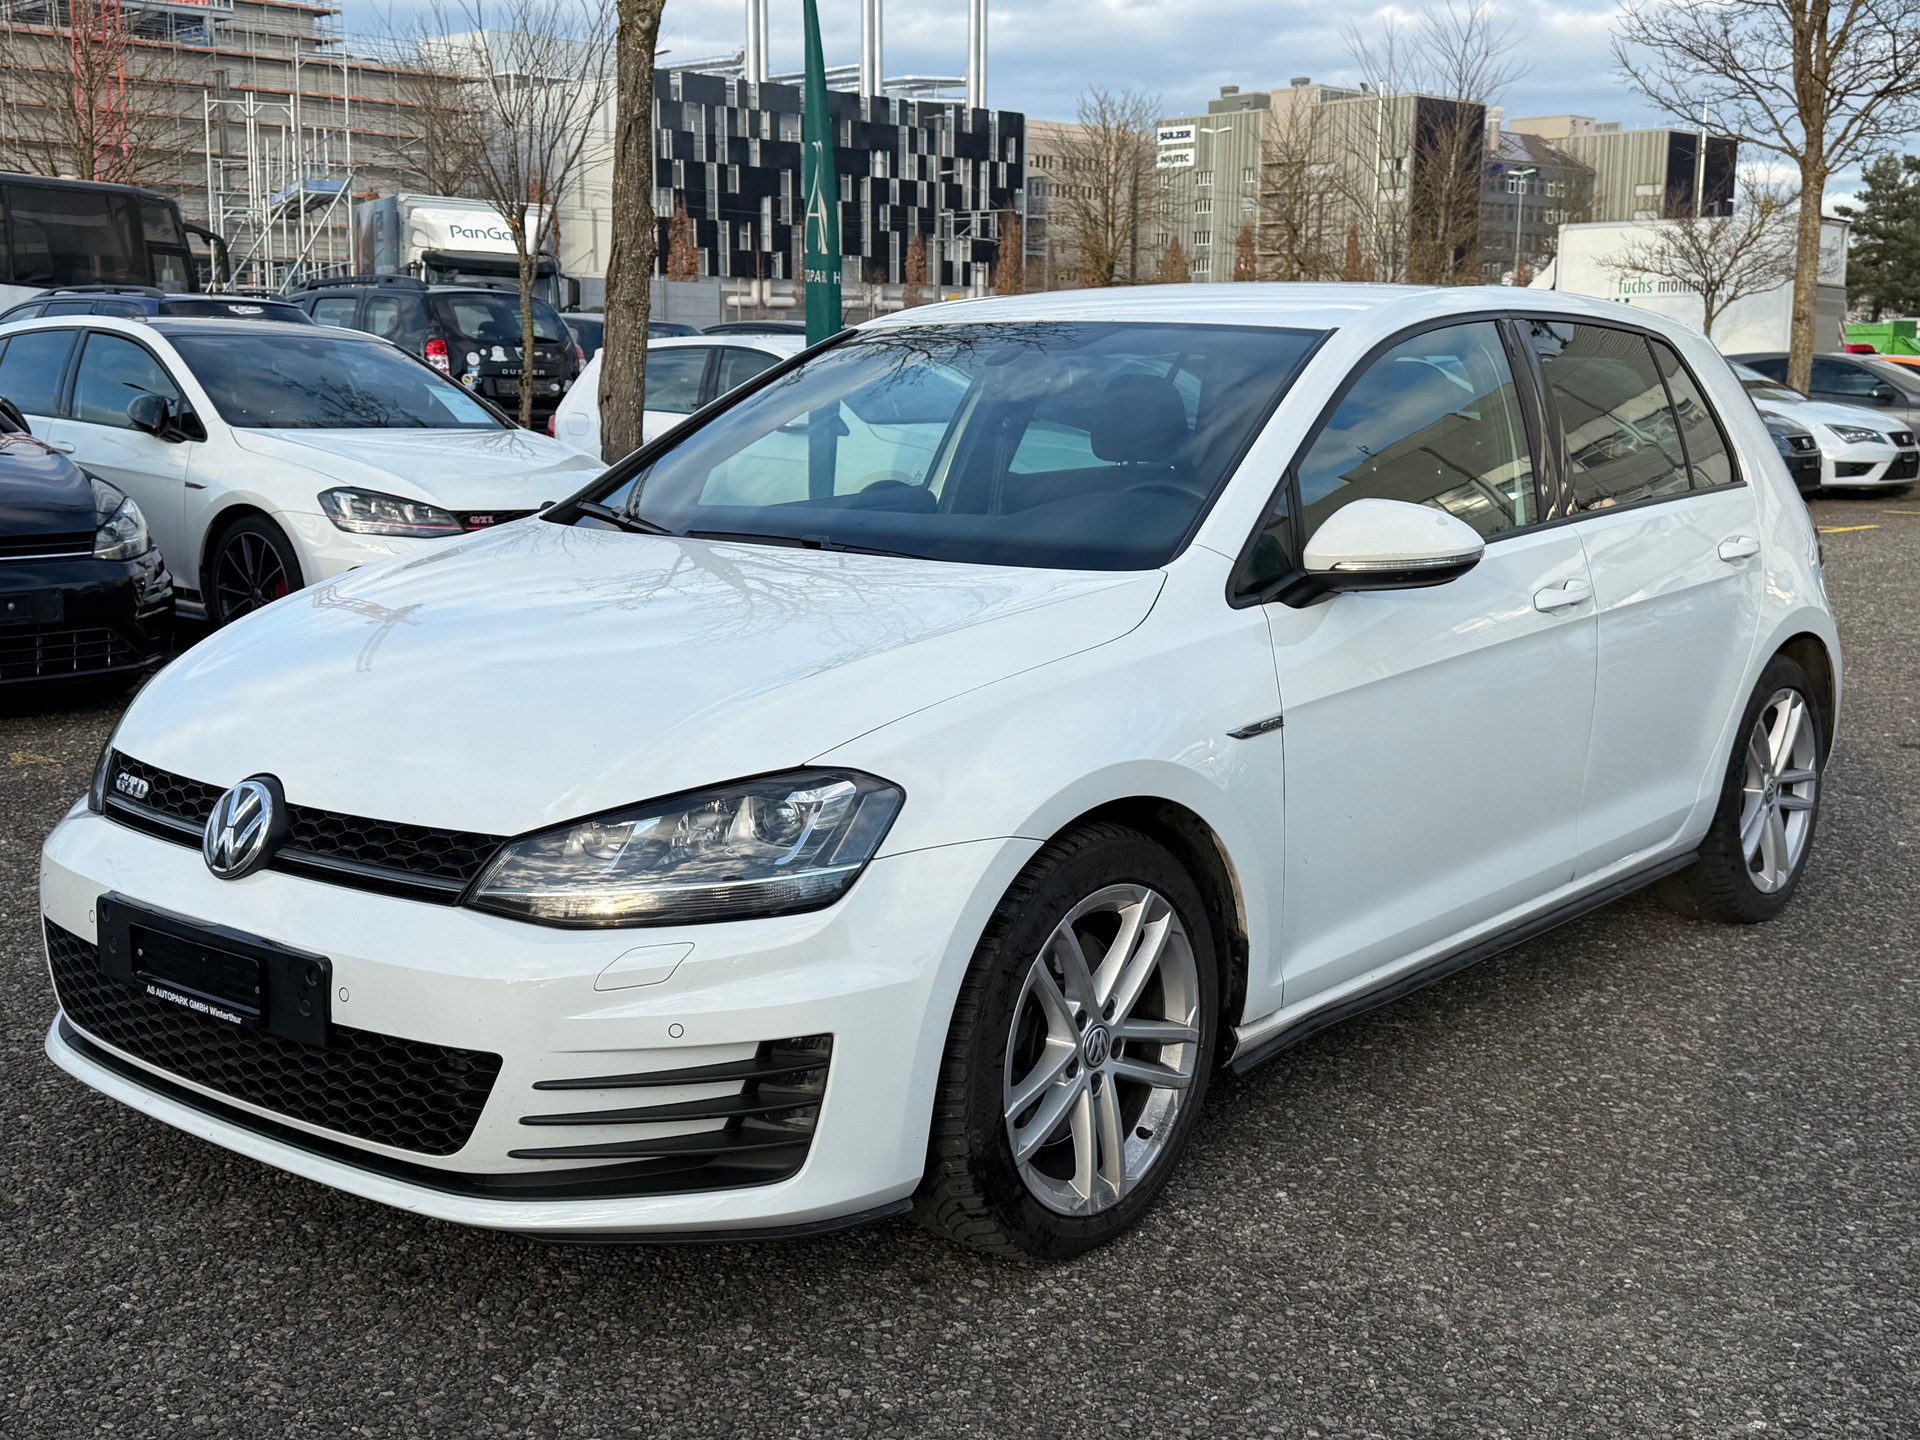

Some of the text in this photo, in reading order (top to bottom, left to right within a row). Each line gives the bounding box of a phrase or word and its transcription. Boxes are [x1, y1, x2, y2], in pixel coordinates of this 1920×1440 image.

[1160, 130, 1191, 140] SULZER
[449, 225, 516, 241] PanGa
[1618, 277, 1653, 294] fuchs
[501, 368, 546, 376] DUSER
[469, 515, 495, 524] GTI
[115, 772, 149, 799] GTD
[146, 984, 242, 1024] AS AUTOPARK GMBH Winterthur
